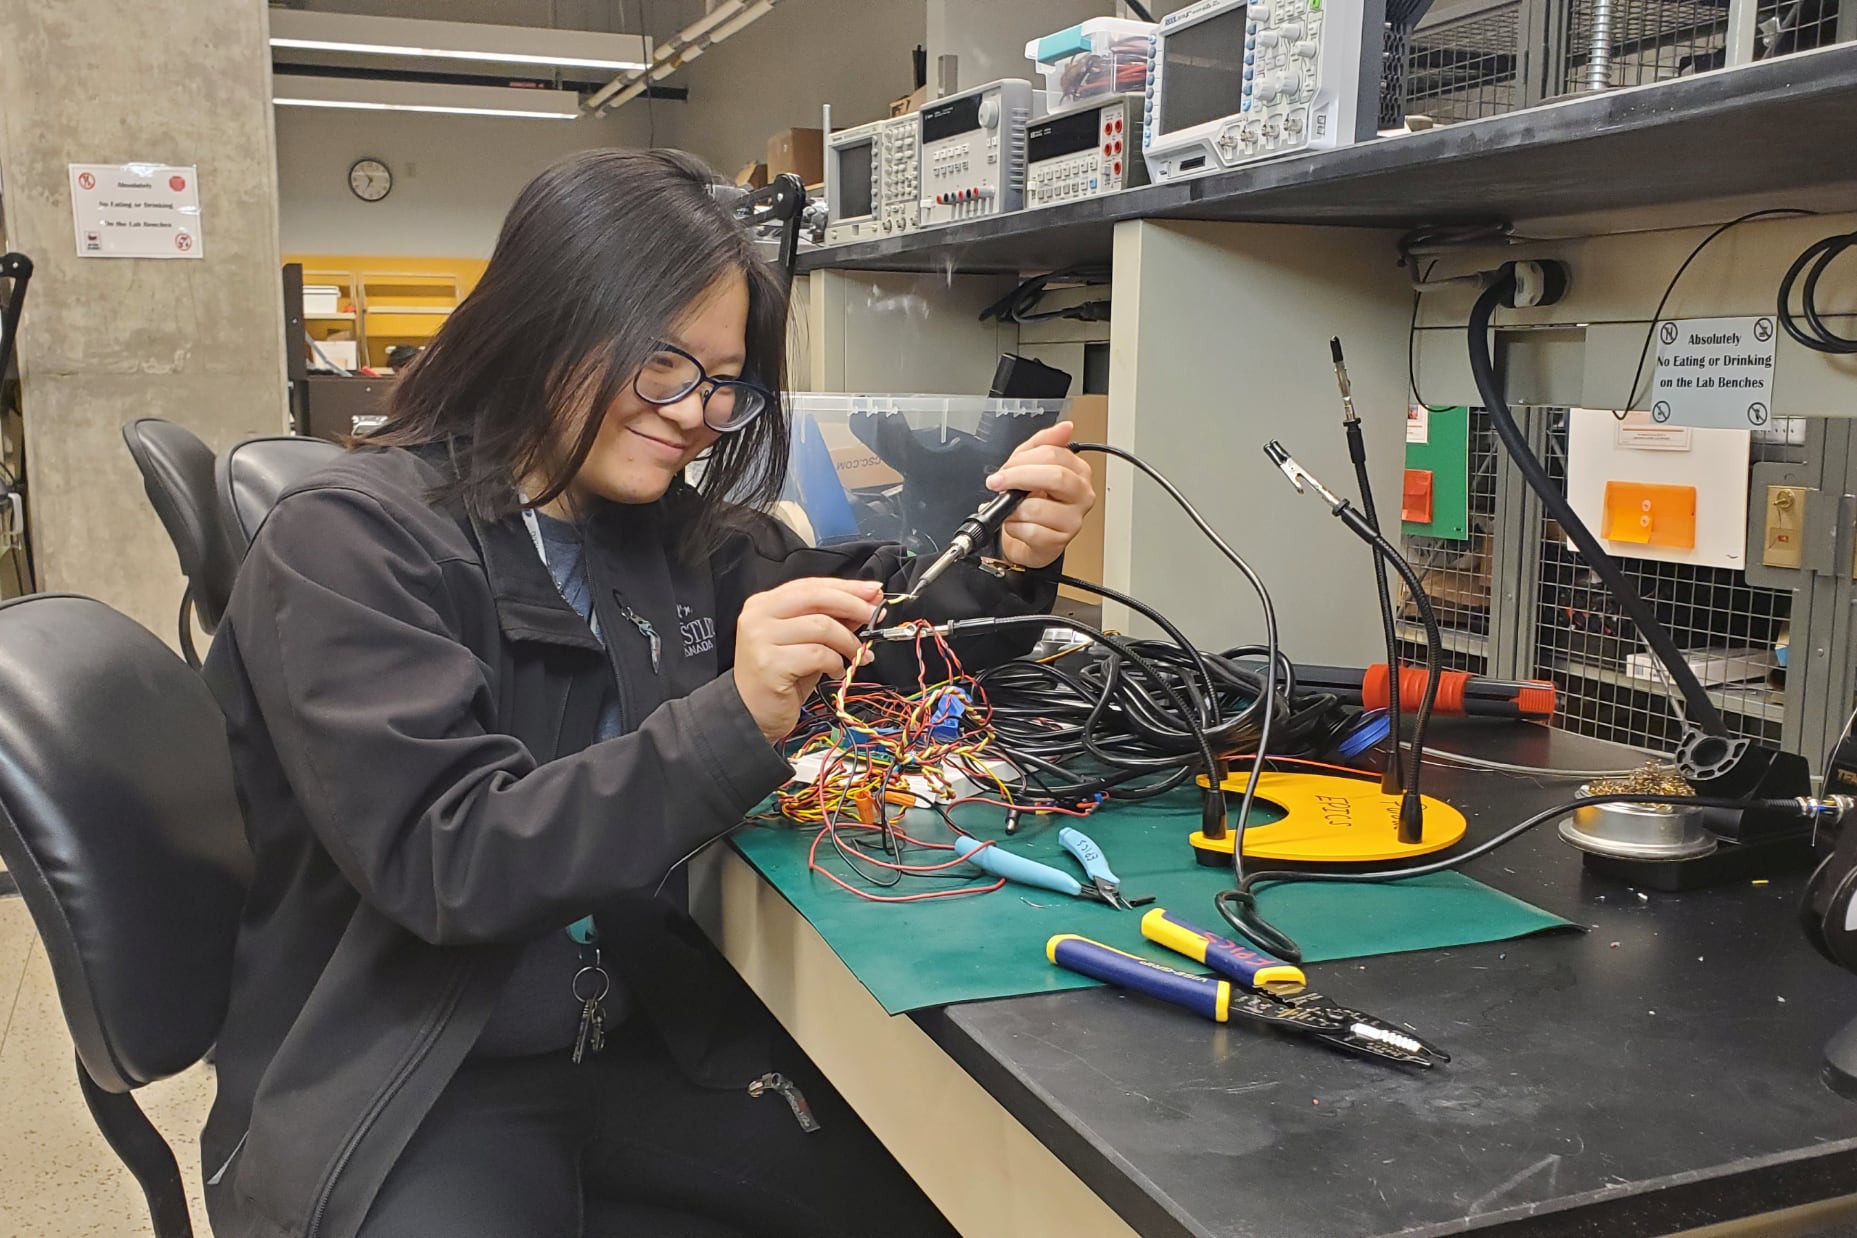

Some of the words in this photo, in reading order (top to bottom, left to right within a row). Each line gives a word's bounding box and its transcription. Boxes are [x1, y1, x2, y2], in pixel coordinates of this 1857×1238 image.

[1688, 333, 1741, 346] Absolutely
[1656, 356, 1670, 367] No
[1673, 355, 1706, 369] Eating
[1708, 356, 1721, 366] or
[1723, 354, 1772, 368] Drinking
[1660, 379, 1673, 388] on
[1676, 377, 1693, 388] the
[1696, 377, 1715, 388] Lab
[1718, 377, 1764, 388] Benches
